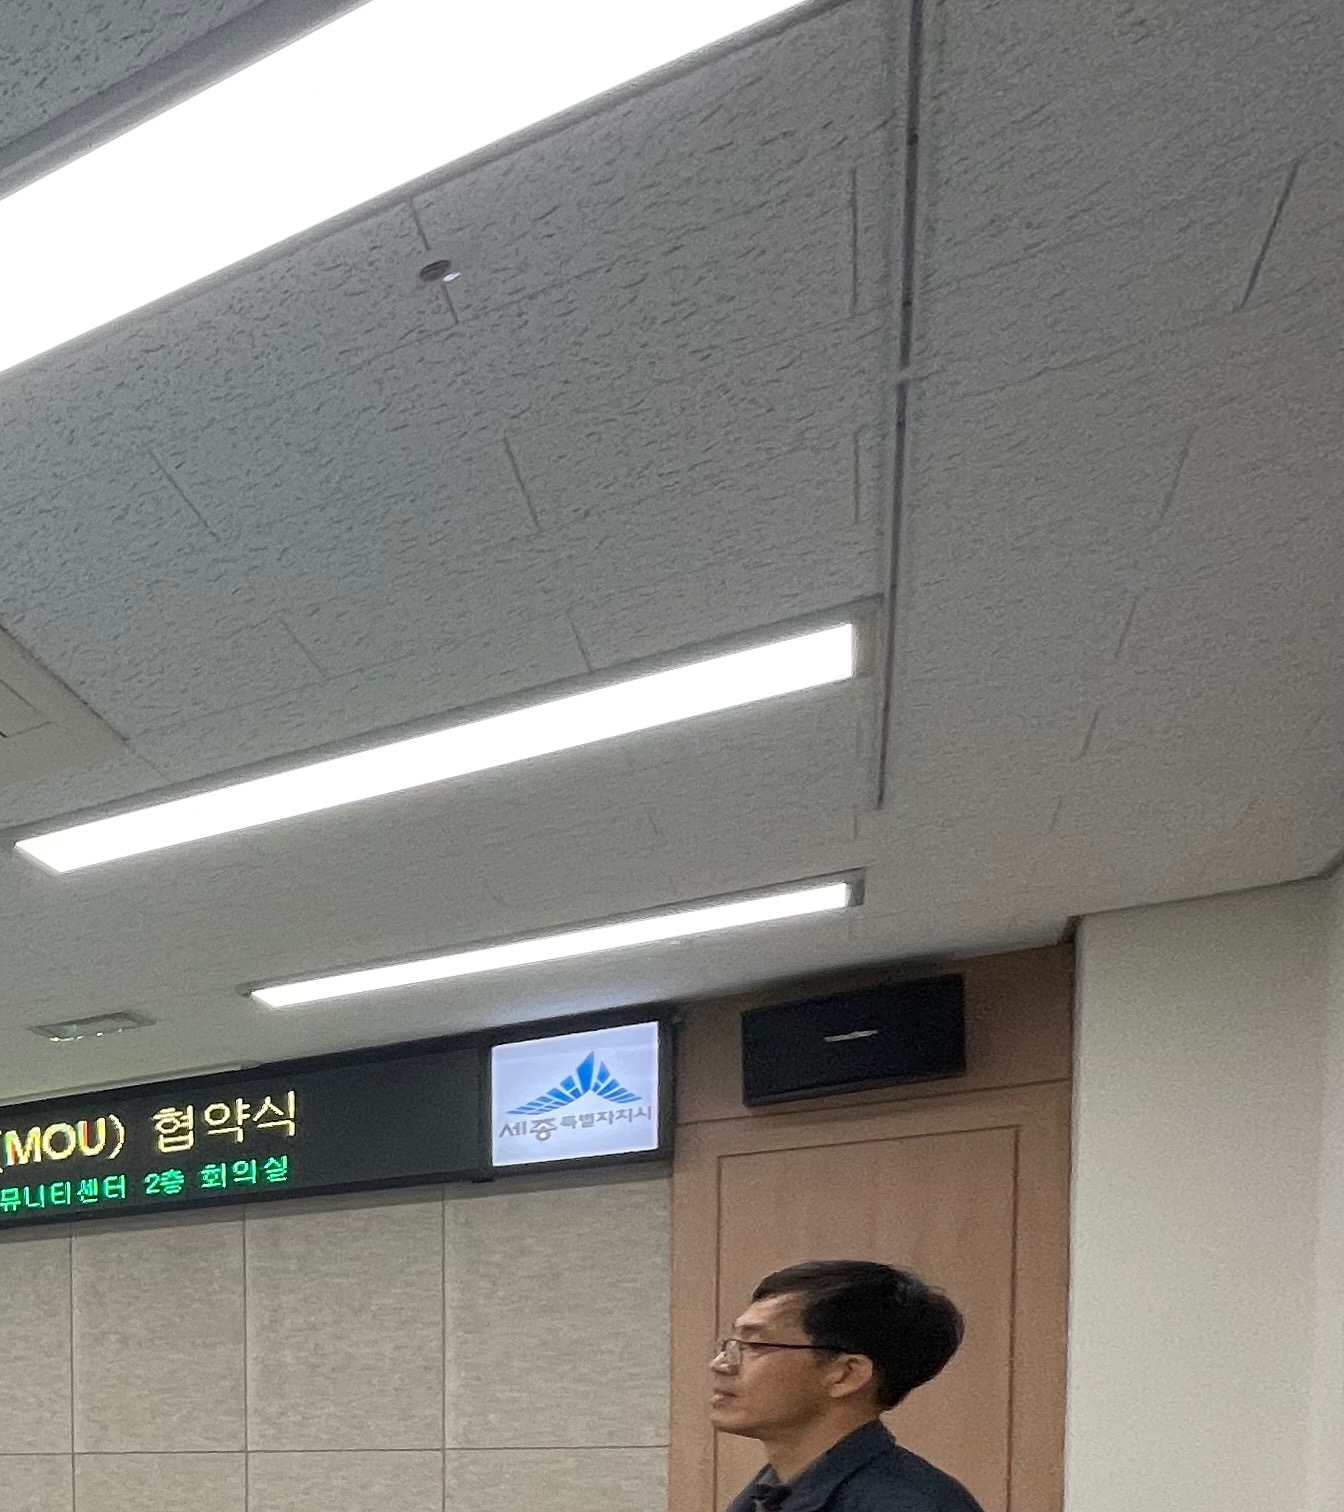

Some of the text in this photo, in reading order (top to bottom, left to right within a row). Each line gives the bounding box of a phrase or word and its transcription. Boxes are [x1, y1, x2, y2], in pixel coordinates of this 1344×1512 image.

[151, 1089, 297, 1154] 협약식
[143, 1168, 186, 1196] 2층
[199, 1154, 289, 1191] 회의실
